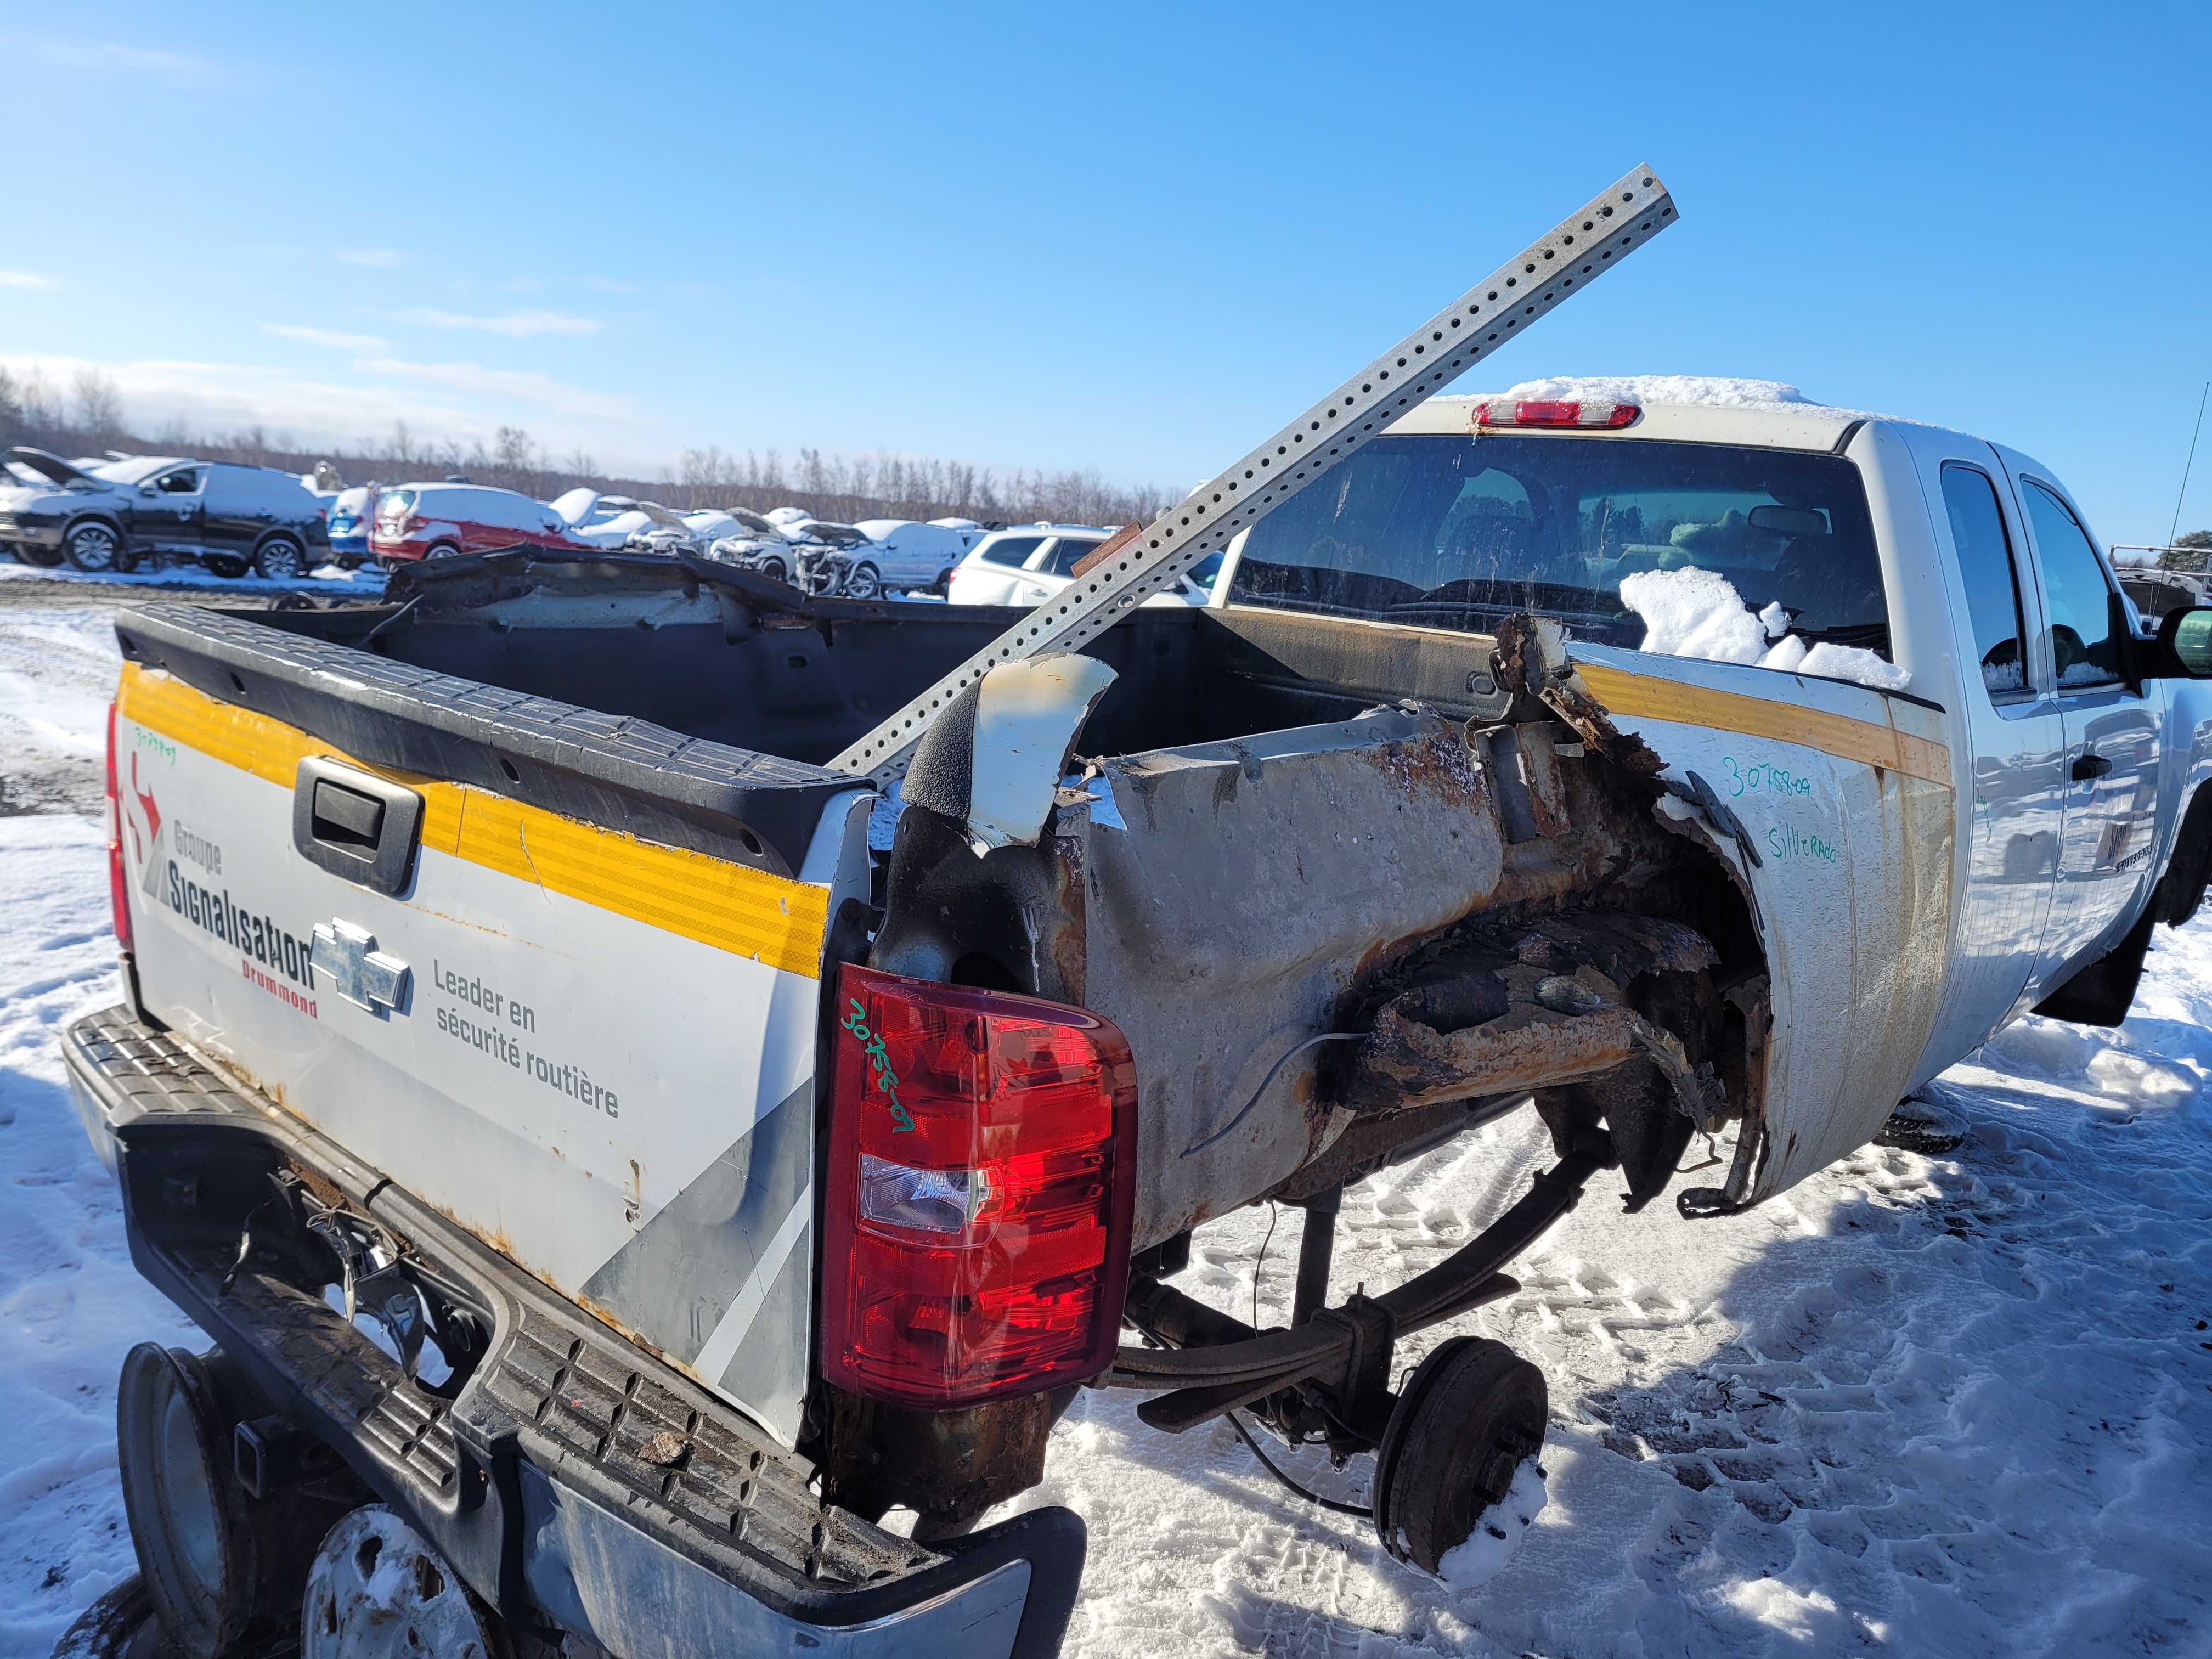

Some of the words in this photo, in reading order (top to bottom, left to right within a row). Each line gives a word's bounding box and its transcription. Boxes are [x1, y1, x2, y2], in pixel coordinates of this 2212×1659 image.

[1723, 757, 1810, 800] 30758-09
[174, 819, 222, 876] Groupe
[241, 959, 318, 1019] Drummond
[433, 959, 504, 1017] Leader
[509, 1000, 535, 1034] en
[437, 1007, 520, 1069] sécurité
[526, 1051, 619, 1119] routière
